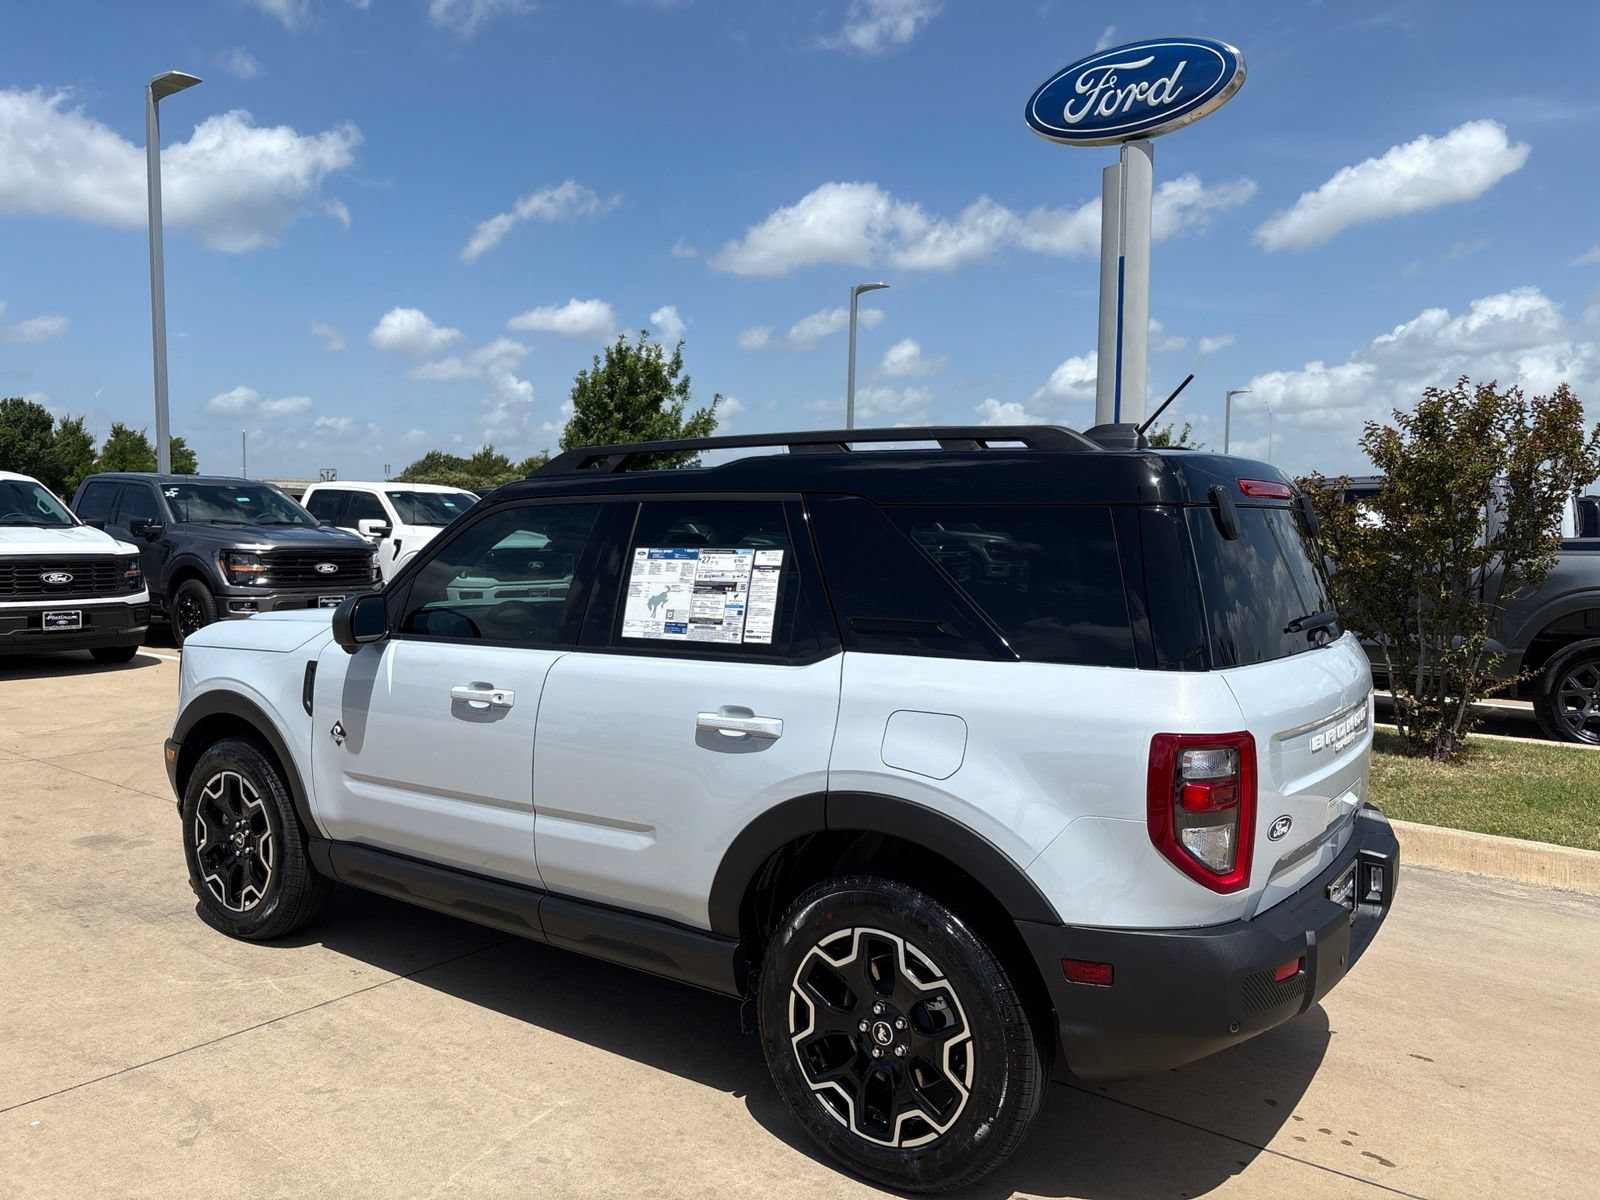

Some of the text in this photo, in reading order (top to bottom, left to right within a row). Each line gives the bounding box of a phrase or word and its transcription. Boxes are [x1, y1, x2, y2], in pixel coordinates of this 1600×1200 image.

[1063, 55, 1188, 124] Ford
[48, 574, 67, 582] Ford
[1311, 706, 1367, 752] BRONCO
[1273, 820, 1290, 838] Ford
